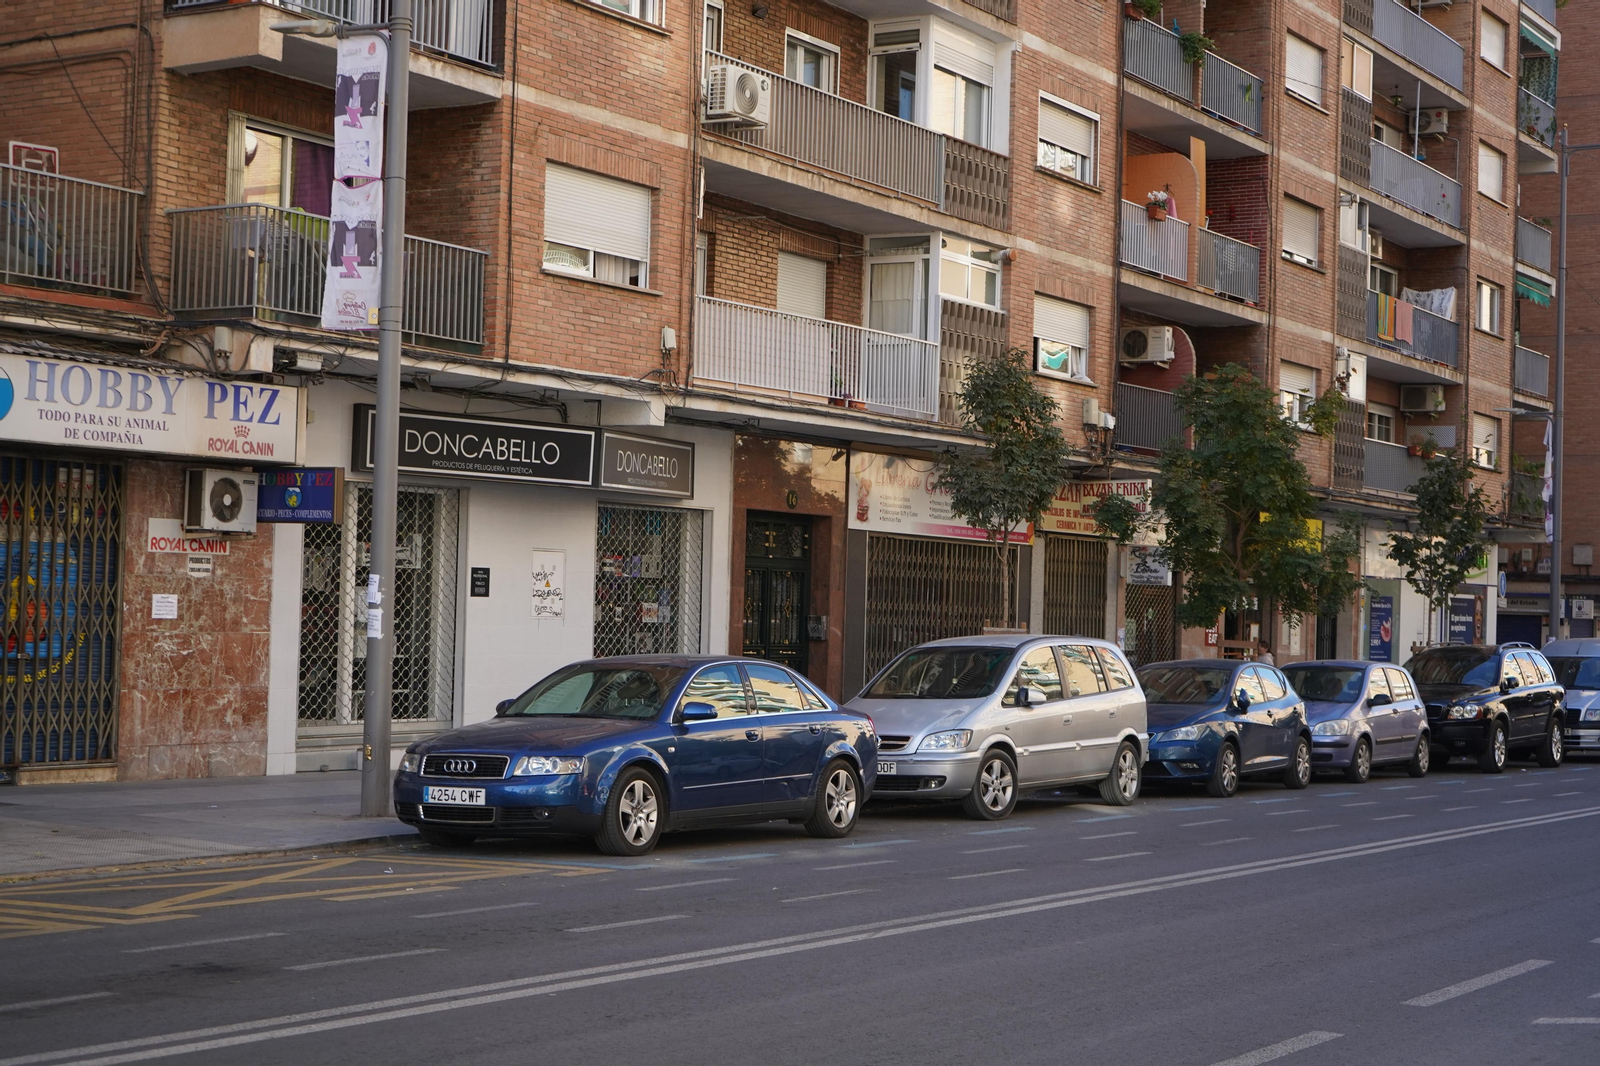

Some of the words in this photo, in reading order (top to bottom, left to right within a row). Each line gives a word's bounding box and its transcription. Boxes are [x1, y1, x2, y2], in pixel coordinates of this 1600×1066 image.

[25, 360, 184, 415] HOBBY
[204, 381, 281, 426] PEZ
[38, 409, 71, 423] TODO
[74, 412, 104, 427] PARA
[107, 415, 122, 428] SU
[125, 417, 169, 432] ANIMAL
[64, 427, 80, 440] DE
[83, 428, 144, 445] COMPAÑIA
[208, 437, 240, 454] ROYAL
[242, 441, 274, 457] CANIN
[404, 429, 560, 465] DONCABELLO
[432, 460, 465, 469] PRODUCTOS
[617, 450, 679, 479] DONCABELLO
[258, 472, 302, 486] HOBBY
[307, 472, 333, 486] PEZ
[1083, 483, 1113, 497] BAZAR
[1116, 482, 1146, 496] ERIKA
[788, 493, 797, 505] 16
[257, 509, 275, 518] CUARIO
[295, 510, 332, 519] COMPLEMENTOS
[1066, 508, 1072, 518] DE
[151, 537, 187, 551] ROYAL
[189, 540, 227, 553] CANIN
[189, 557, 211, 566] PRODUCTOS
[430, 788, 457, 802] 4254
[460, 789, 483, 803] CWF
